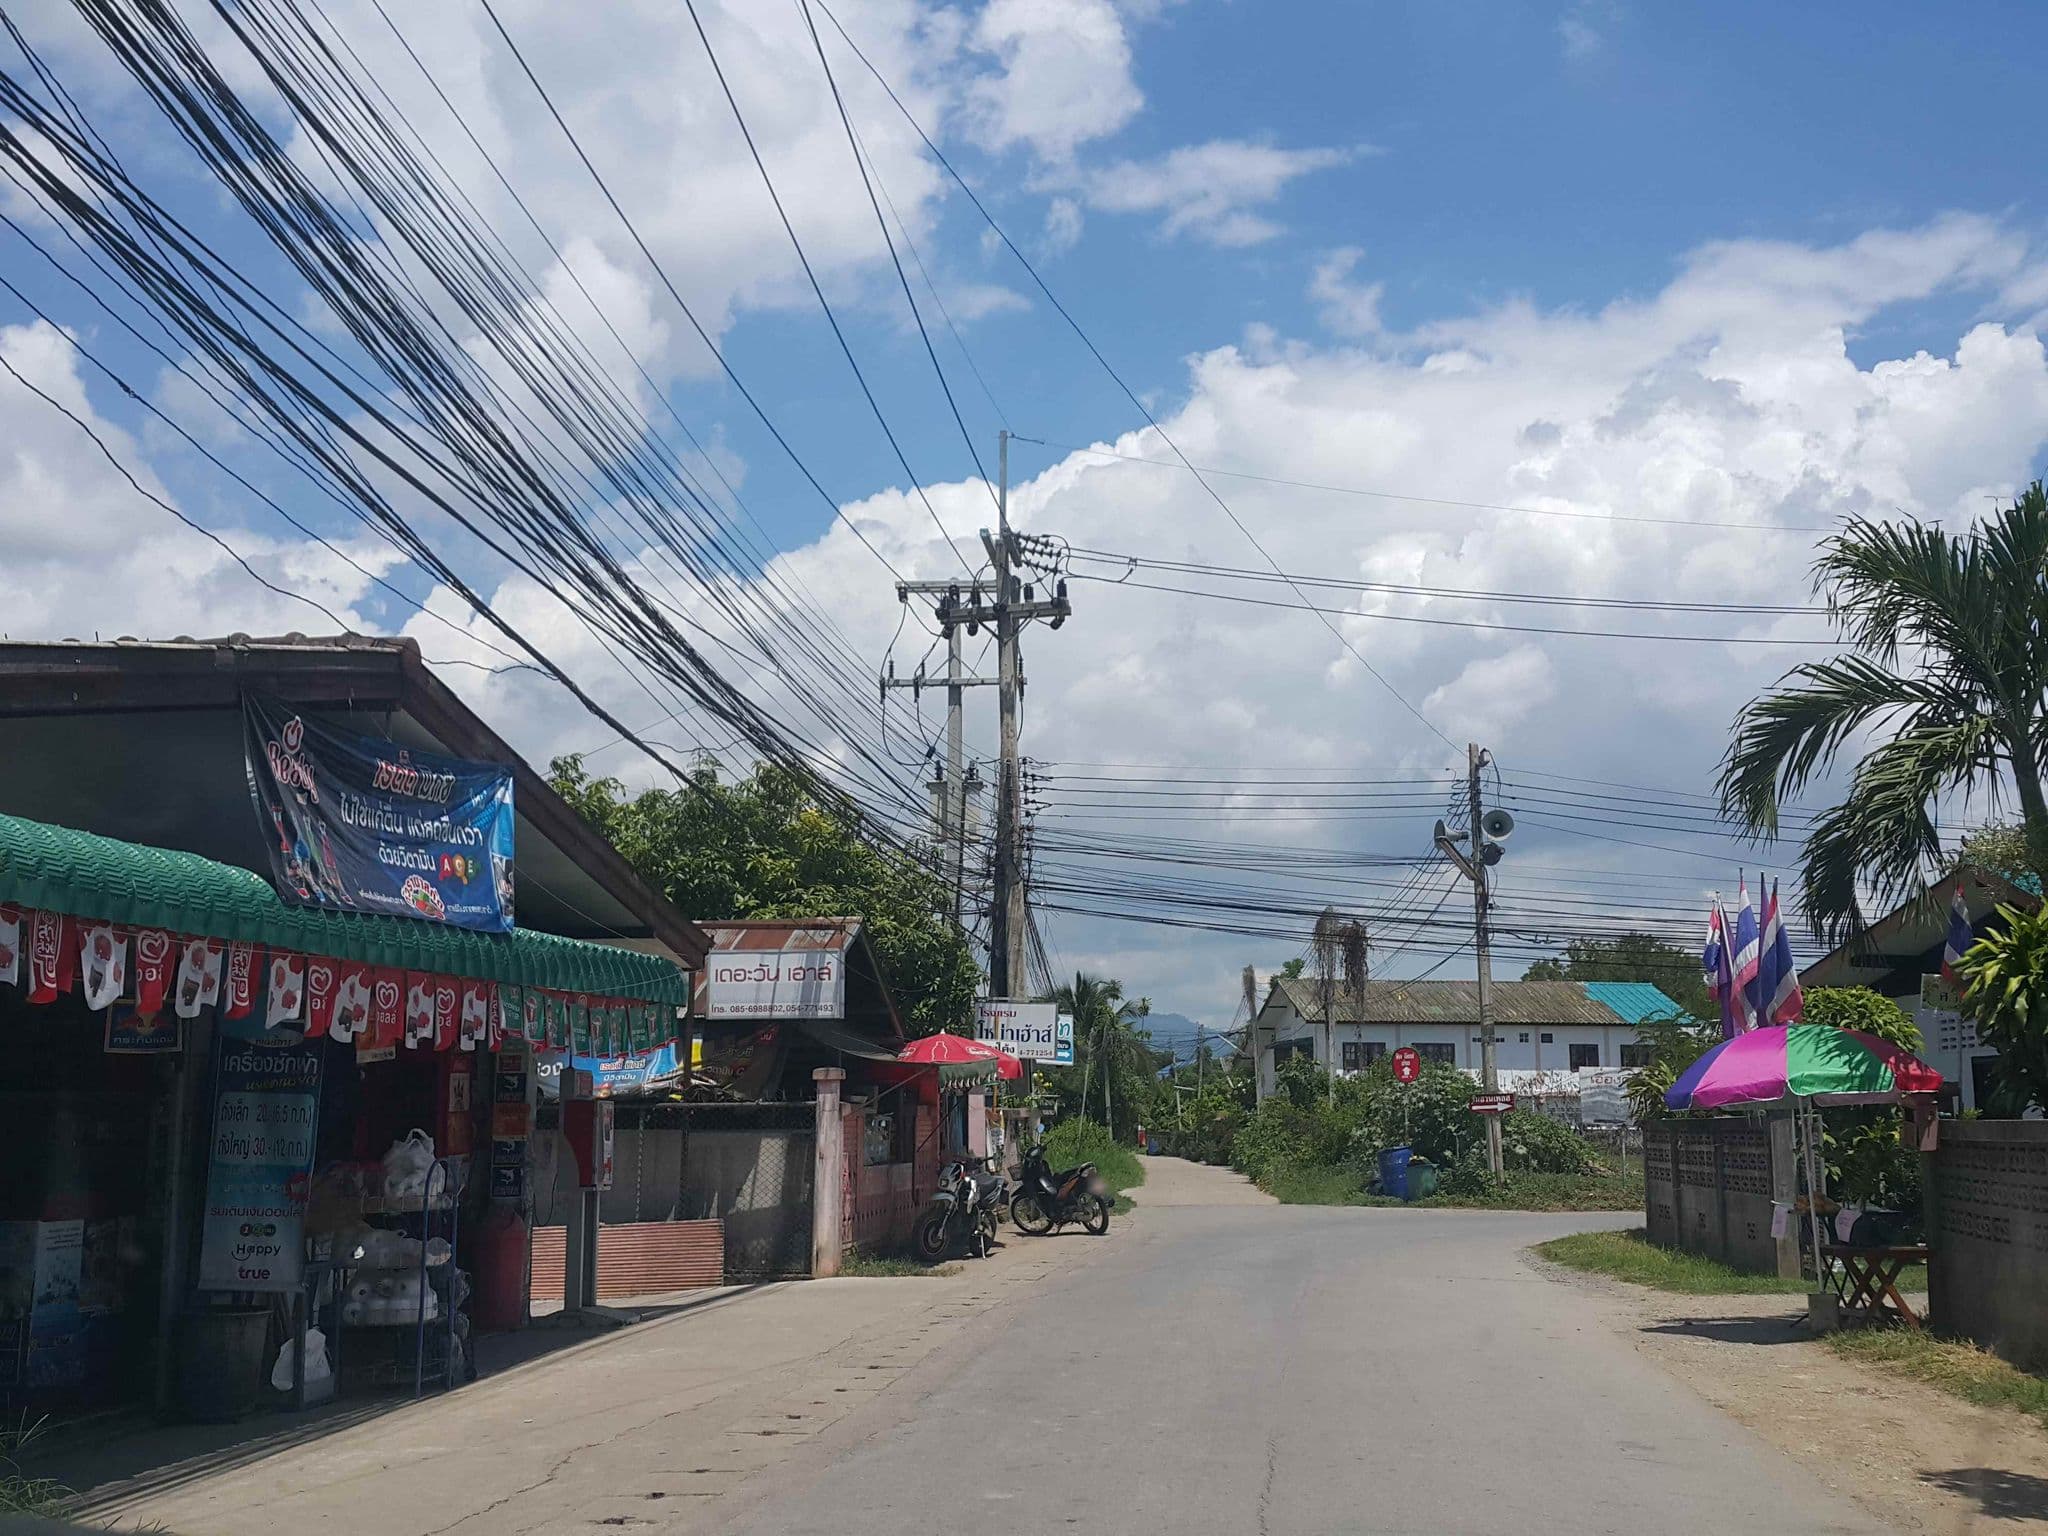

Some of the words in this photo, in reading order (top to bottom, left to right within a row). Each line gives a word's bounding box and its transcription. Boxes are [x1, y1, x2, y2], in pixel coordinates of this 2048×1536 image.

[715, 963, 780, 982] เดอะวัน
[224, 1046, 318, 1073] เครื่องซักผ้า
[238, 1265, 271, 1280] true
